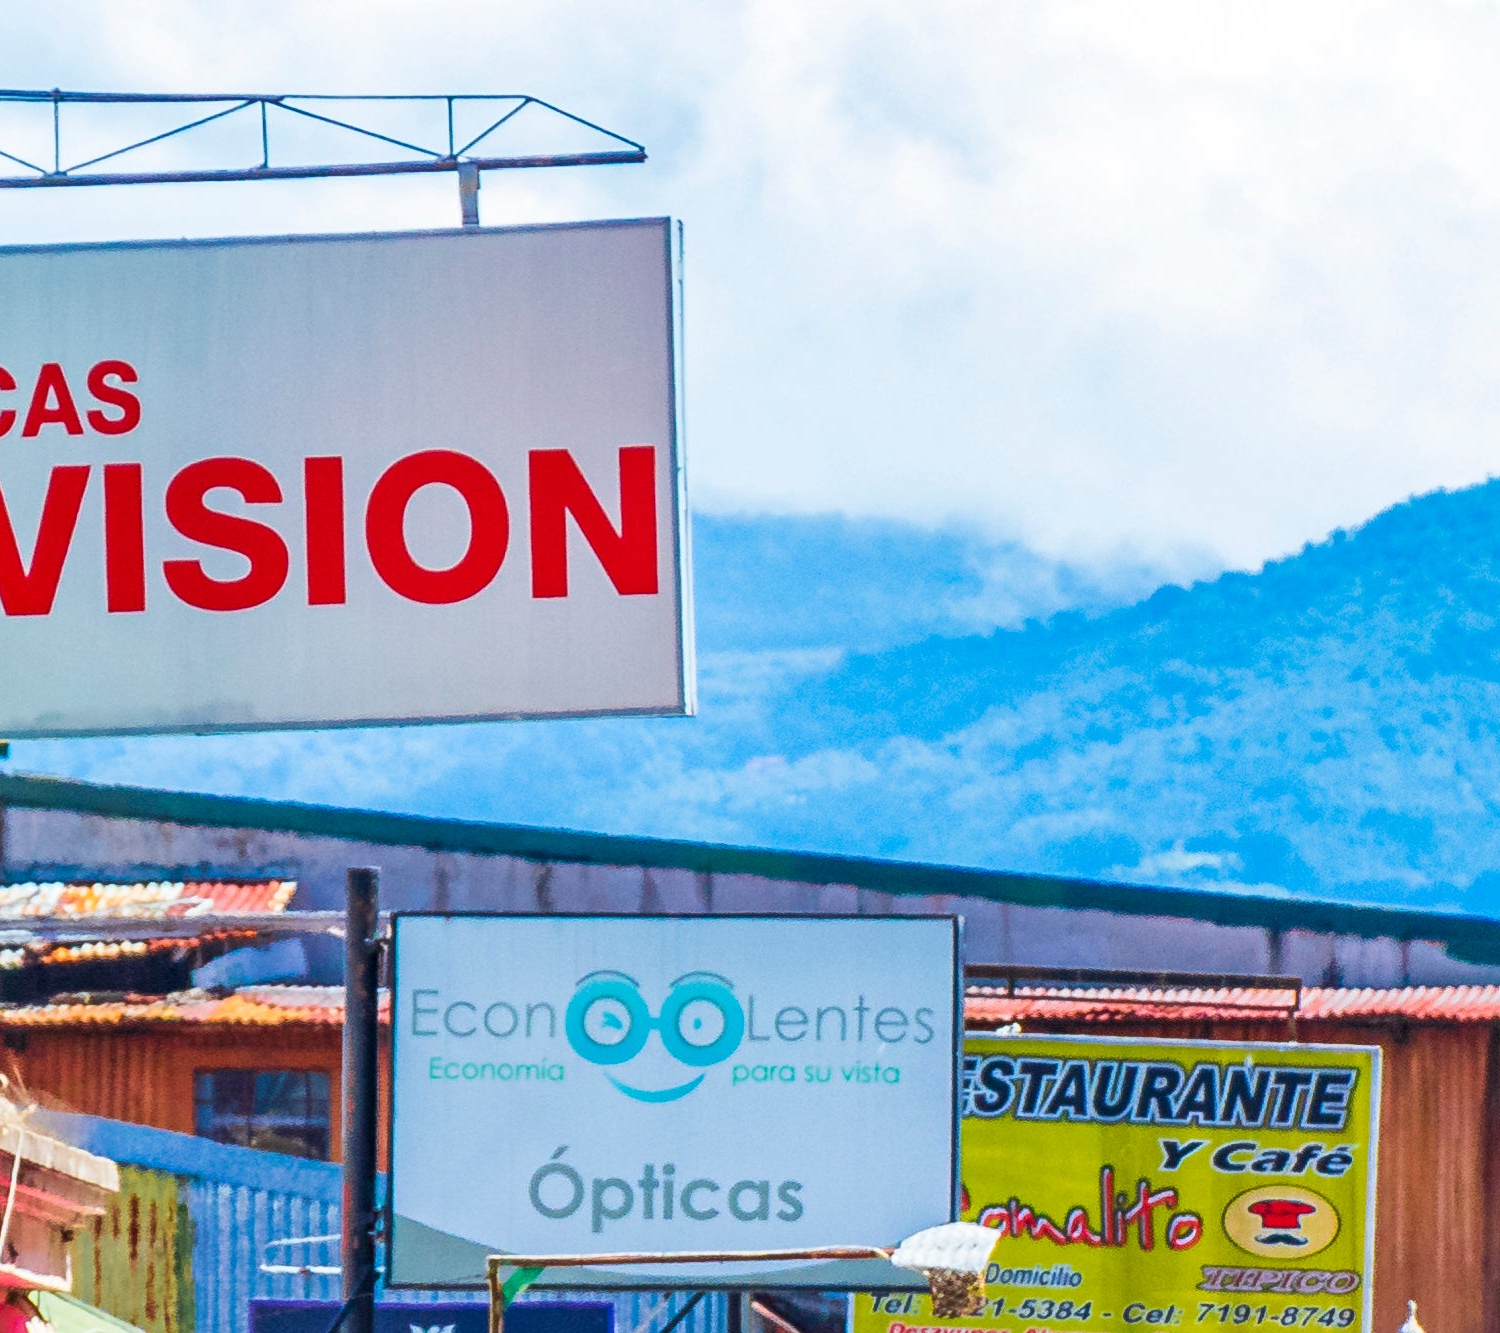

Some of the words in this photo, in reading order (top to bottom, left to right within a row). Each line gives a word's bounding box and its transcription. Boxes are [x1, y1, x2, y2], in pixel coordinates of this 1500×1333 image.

[428, 1058, 566, 1083] Economía
[732, 1062, 795, 1087] para
[803, 1064, 832, 1084] su
[840, 1060, 901, 1085] vista
[1158, 1140, 1207, 1173] Y
[1211, 1139, 1355, 1178] Café
[528, 1144, 805, 1234] Ópticas
[986, 1262, 1083, 1288] Domicilio
[1199, 1267, 1361, 1294] TIPICO
[1196, 1303, 1357, 1329] 7191-8749
